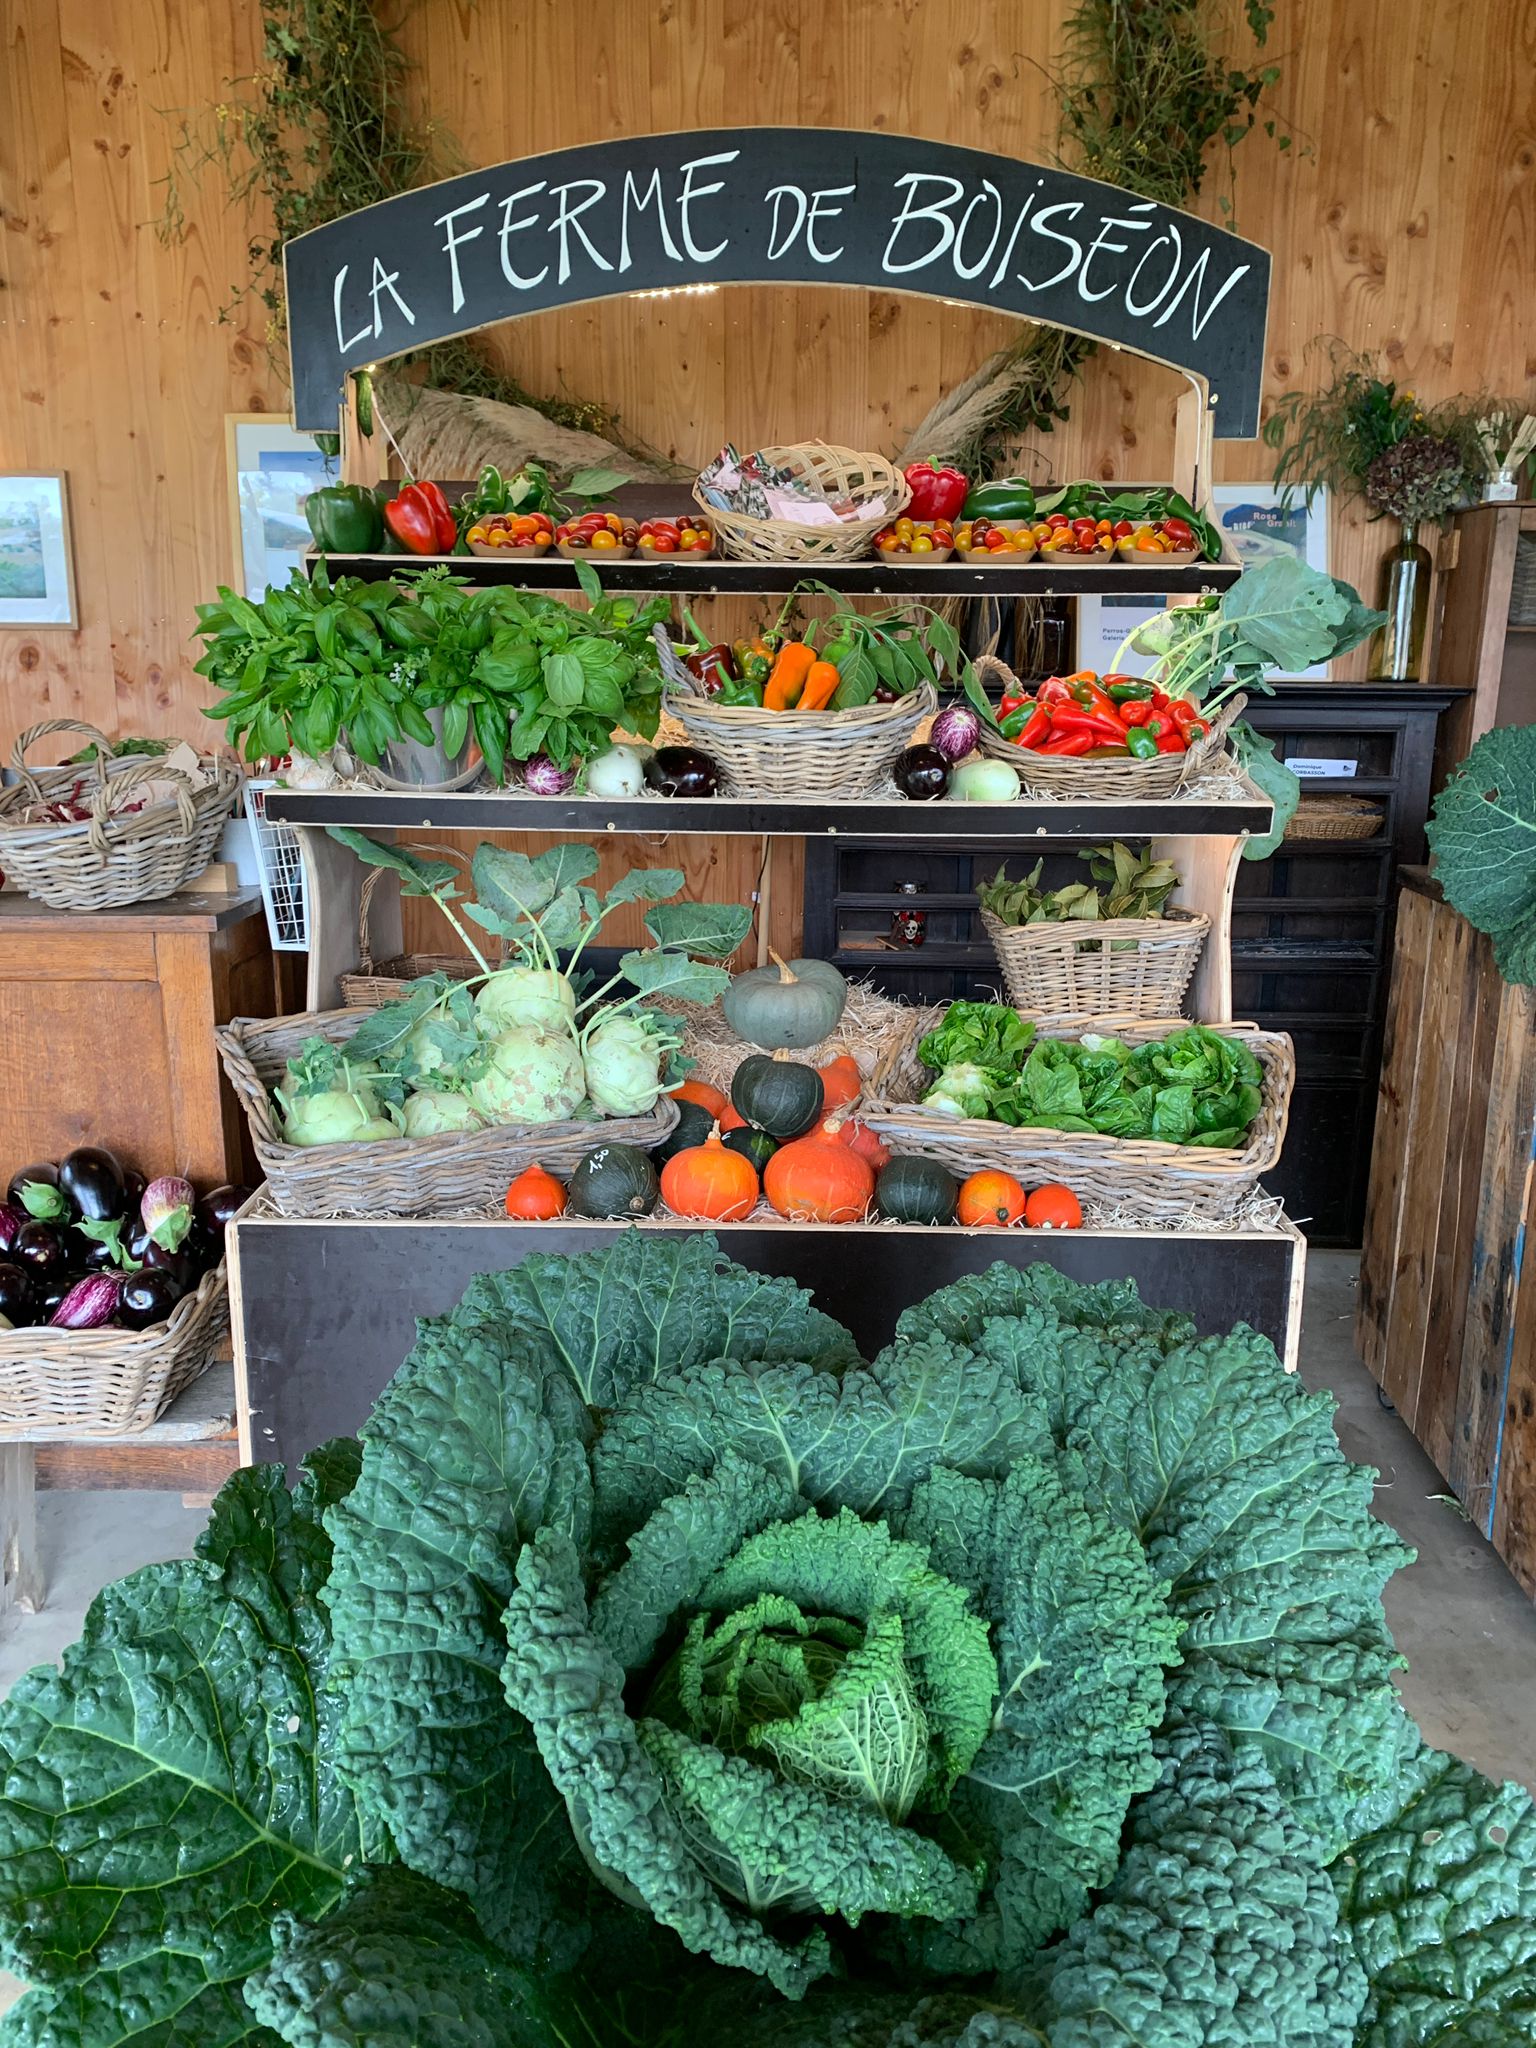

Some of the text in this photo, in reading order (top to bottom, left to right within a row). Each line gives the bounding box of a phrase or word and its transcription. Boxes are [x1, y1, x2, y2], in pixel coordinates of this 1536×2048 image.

[334, 258, 416, 354] LA
[434, 151, 740, 314] FERME
[765, 185, 857, 263] DE
[1253, 512, 1277, 520] Rose
[589, 1149, 609, 1173] 1,50
